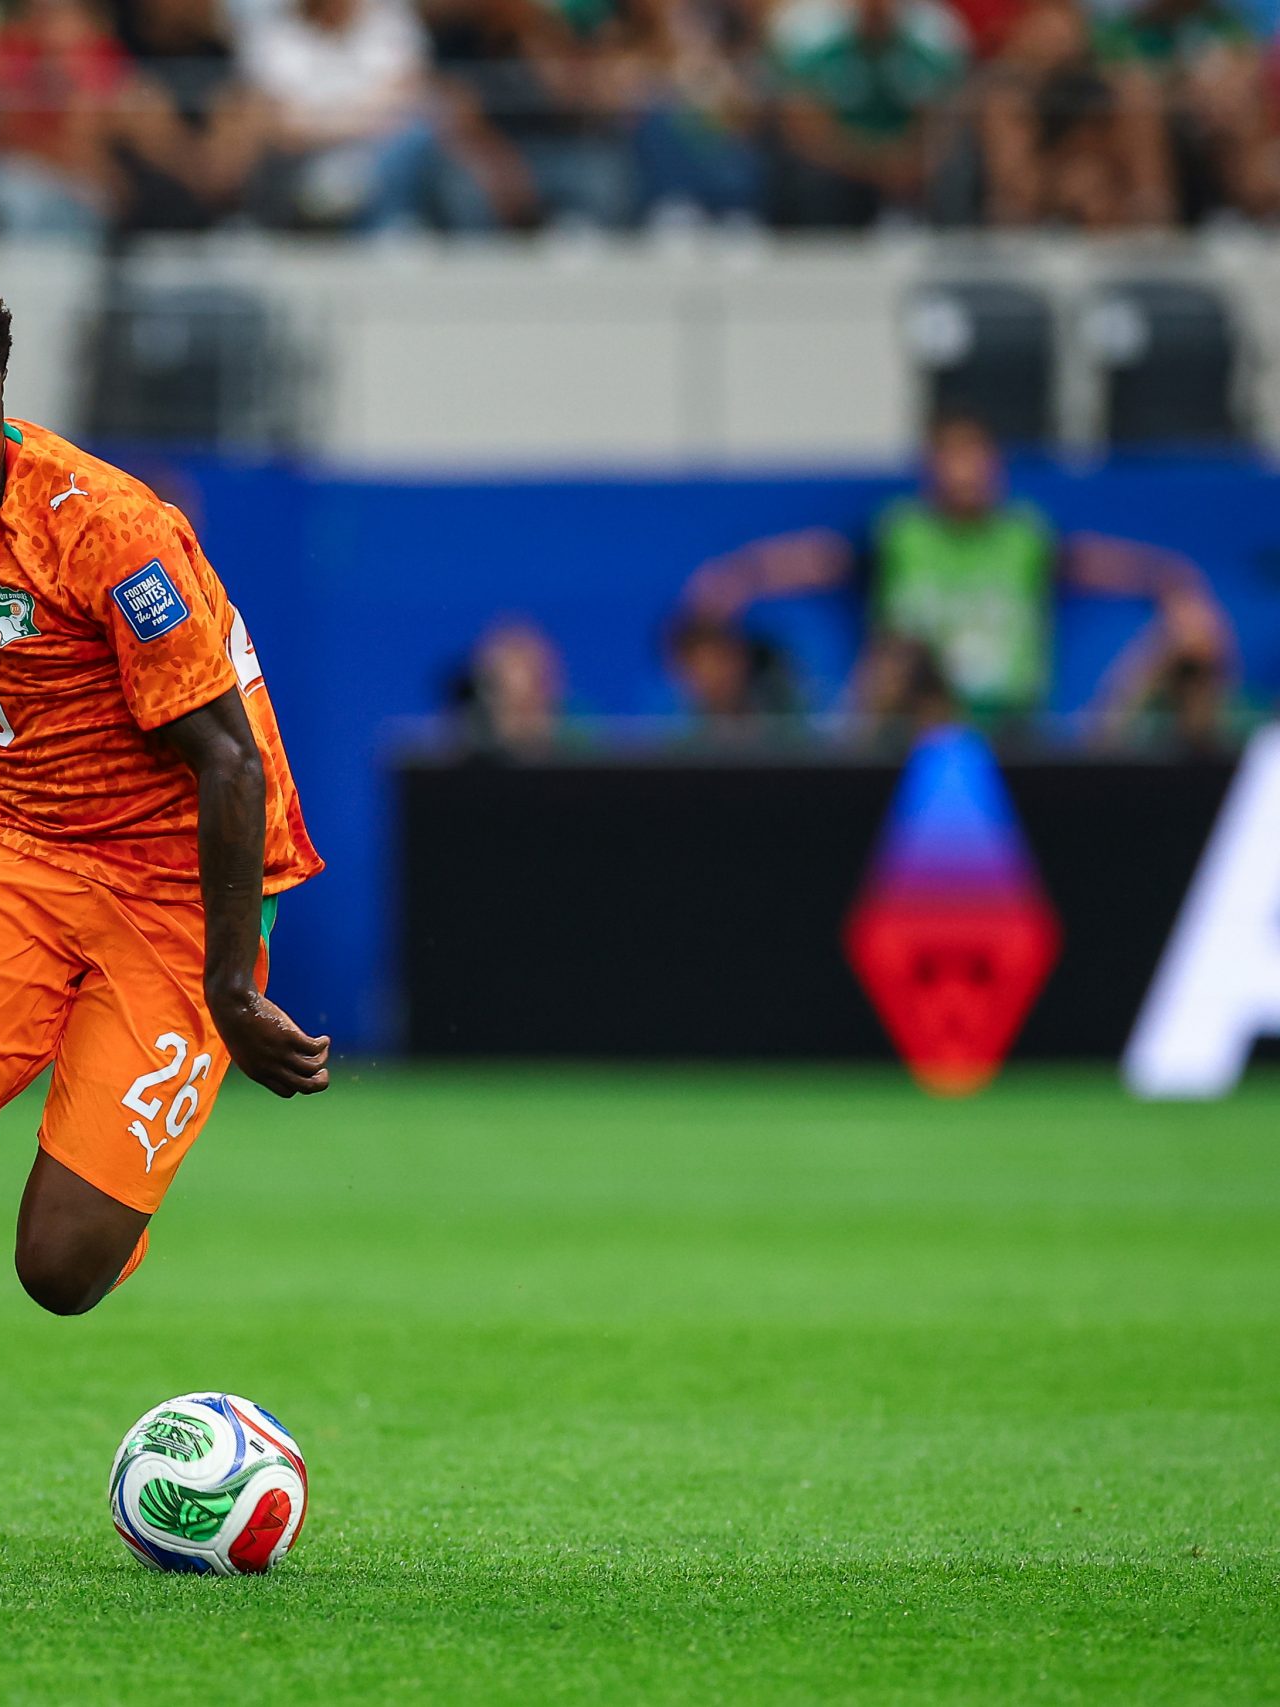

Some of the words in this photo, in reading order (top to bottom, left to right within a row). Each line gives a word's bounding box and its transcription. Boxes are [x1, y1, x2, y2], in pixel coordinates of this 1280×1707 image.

[123, 573, 160, 601] FOOTBALL
[128, 582, 167, 612] UNITES
[134, 610, 151, 624] the
[149, 593, 175, 618] World
[152, 613, 169, 626] FIFA
[120, 1031, 213, 1138] 26
